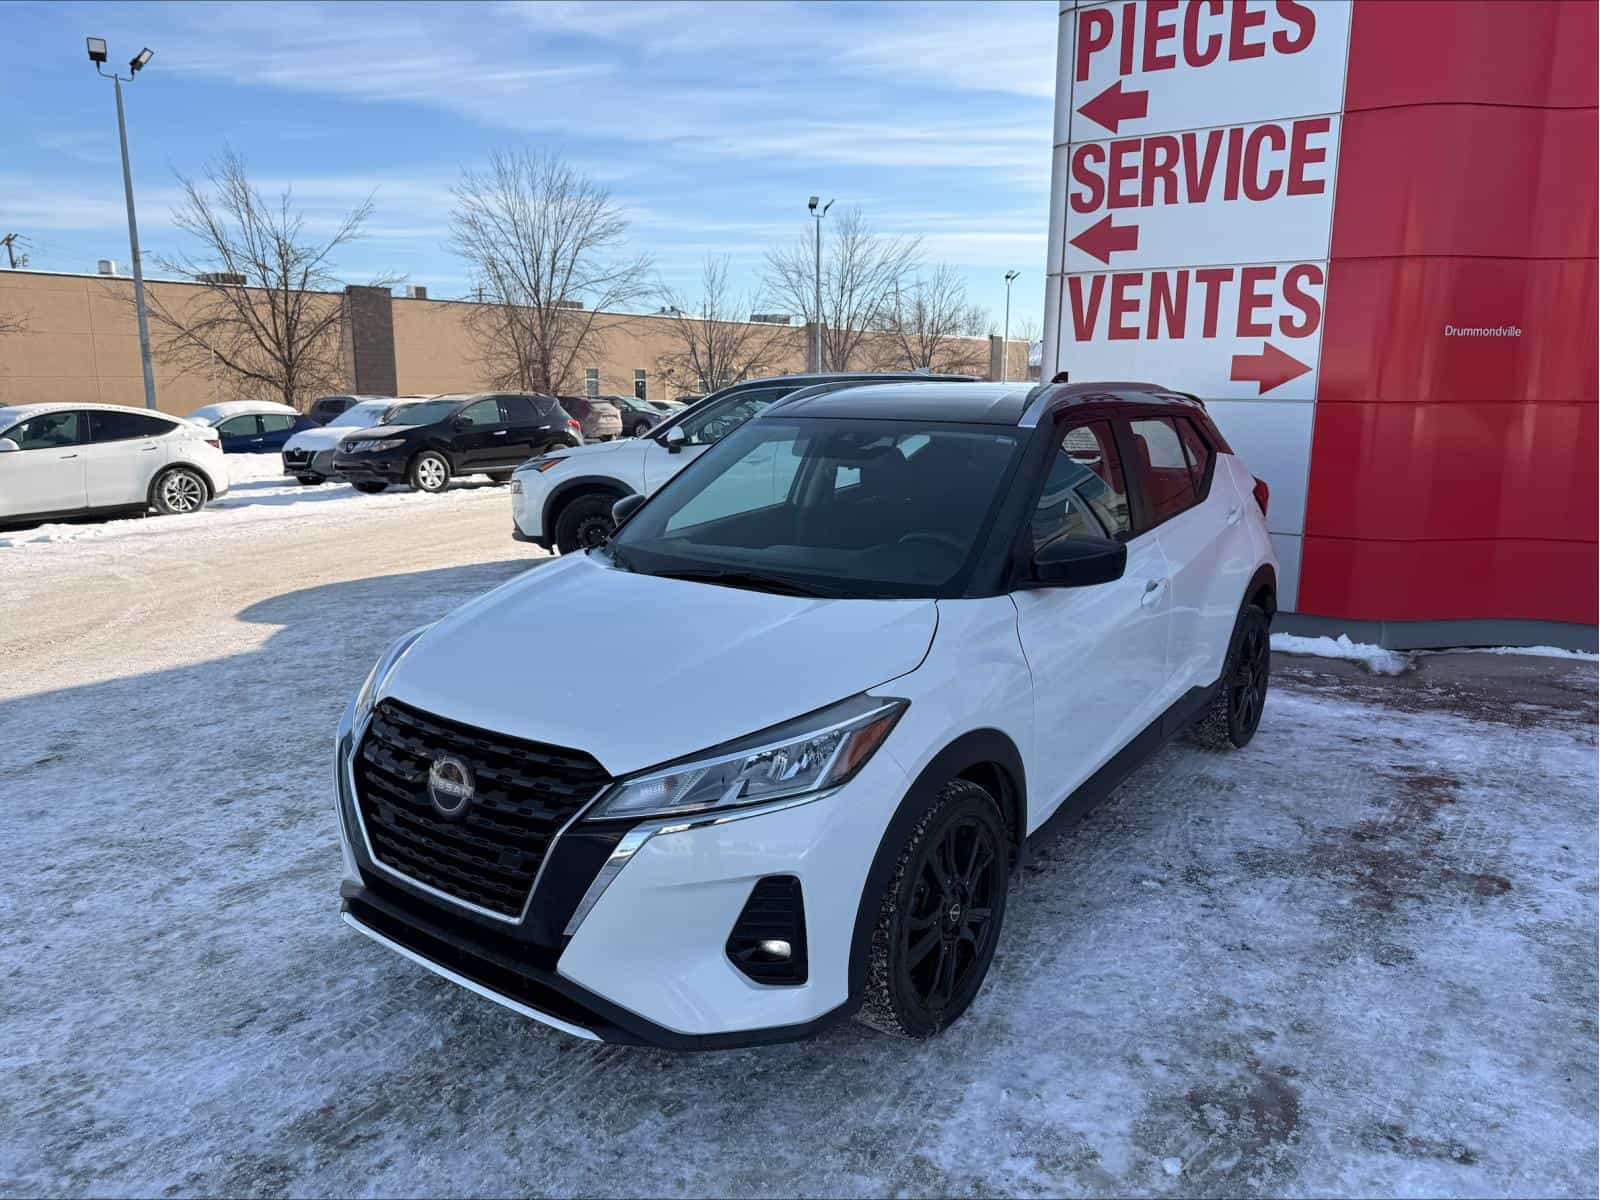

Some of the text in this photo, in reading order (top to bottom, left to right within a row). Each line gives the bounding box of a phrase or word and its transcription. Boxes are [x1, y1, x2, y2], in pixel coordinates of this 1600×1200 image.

[1070, 118, 1330, 213] SERVICE
[1068, 264, 1324, 341] VENTES
[1444, 325, 1521, 337] Drummondville
